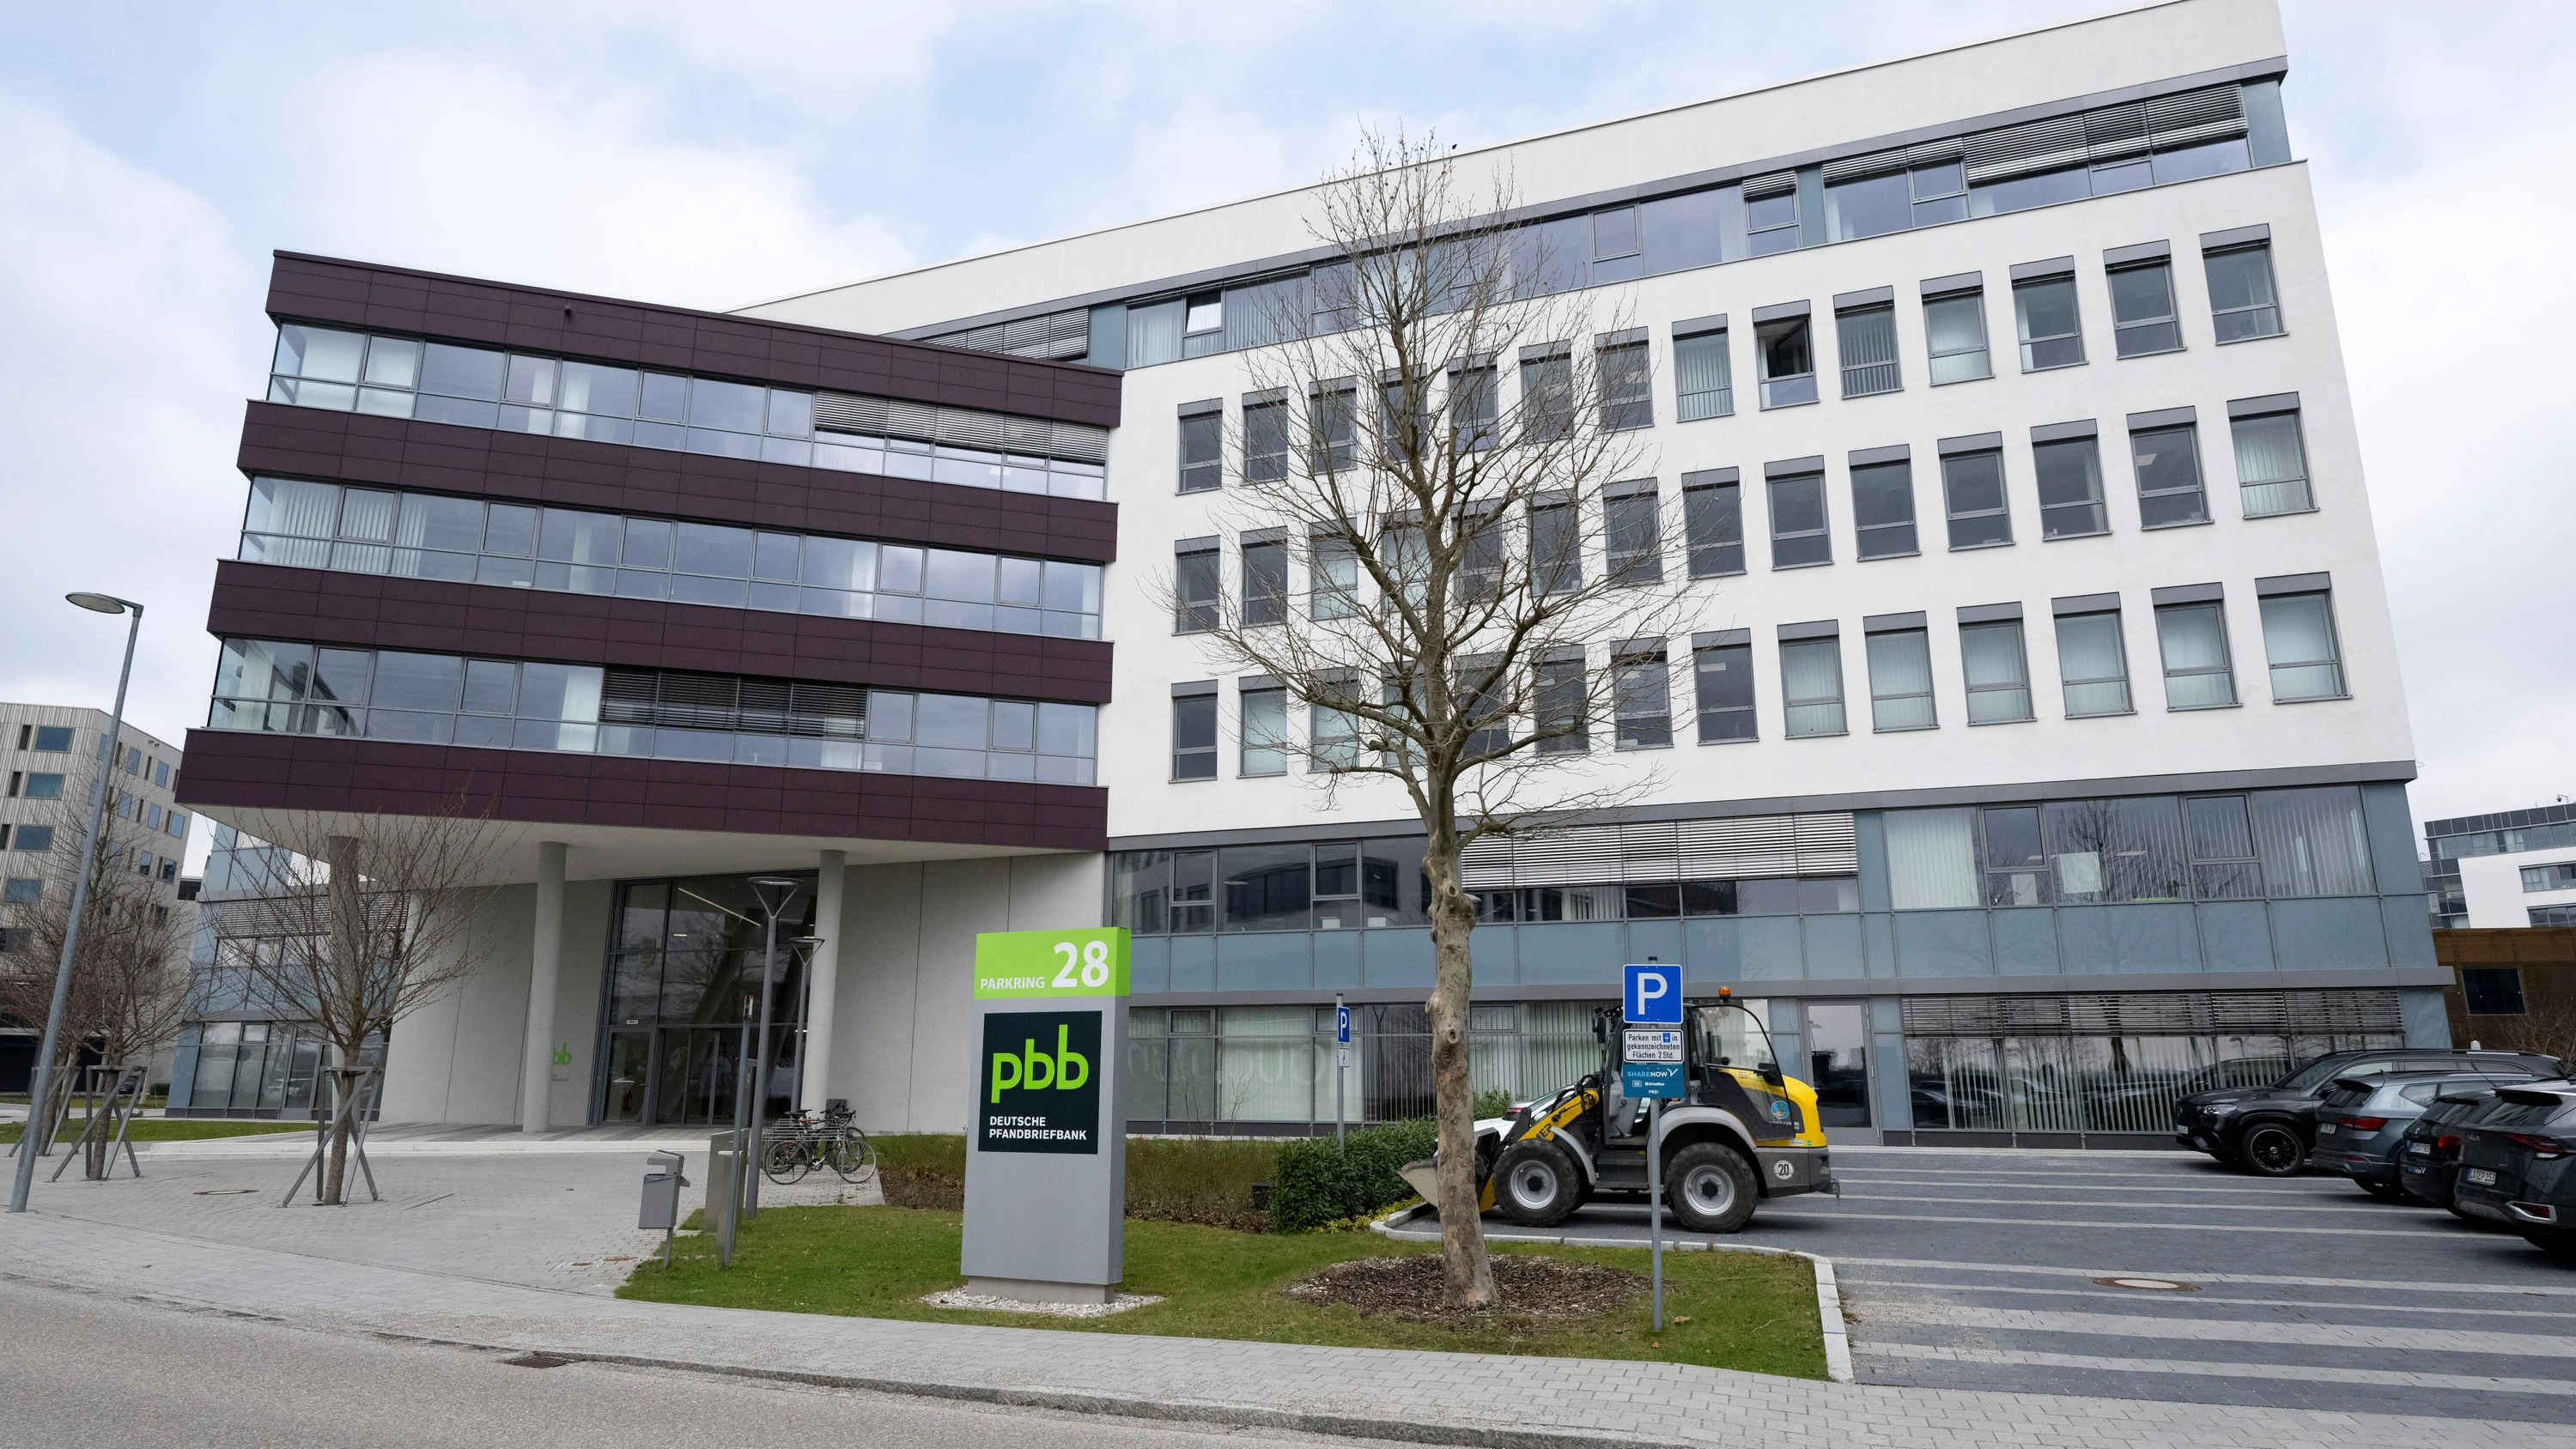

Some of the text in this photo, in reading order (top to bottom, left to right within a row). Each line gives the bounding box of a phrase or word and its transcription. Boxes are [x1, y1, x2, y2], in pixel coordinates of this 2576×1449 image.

[980, 940, 1109, 990] PARKRING 28
[1637, 973, 1668, 1015] P
[1340, 1011, 1347, 1038] P
[552, 1042, 573, 1065] bb
[1626, 1043, 1680, 1052] gekennzeichneten
[1662, 1051, 1675, 1059] Std.
[991, 1024, 1089, 1103] pbb
[989, 1116, 1047, 1126] DEUTSCHE
[989, 1129, 1087, 1140] PFANDBRIEFBANK
[1777, 1164, 1789, 1176] 20
